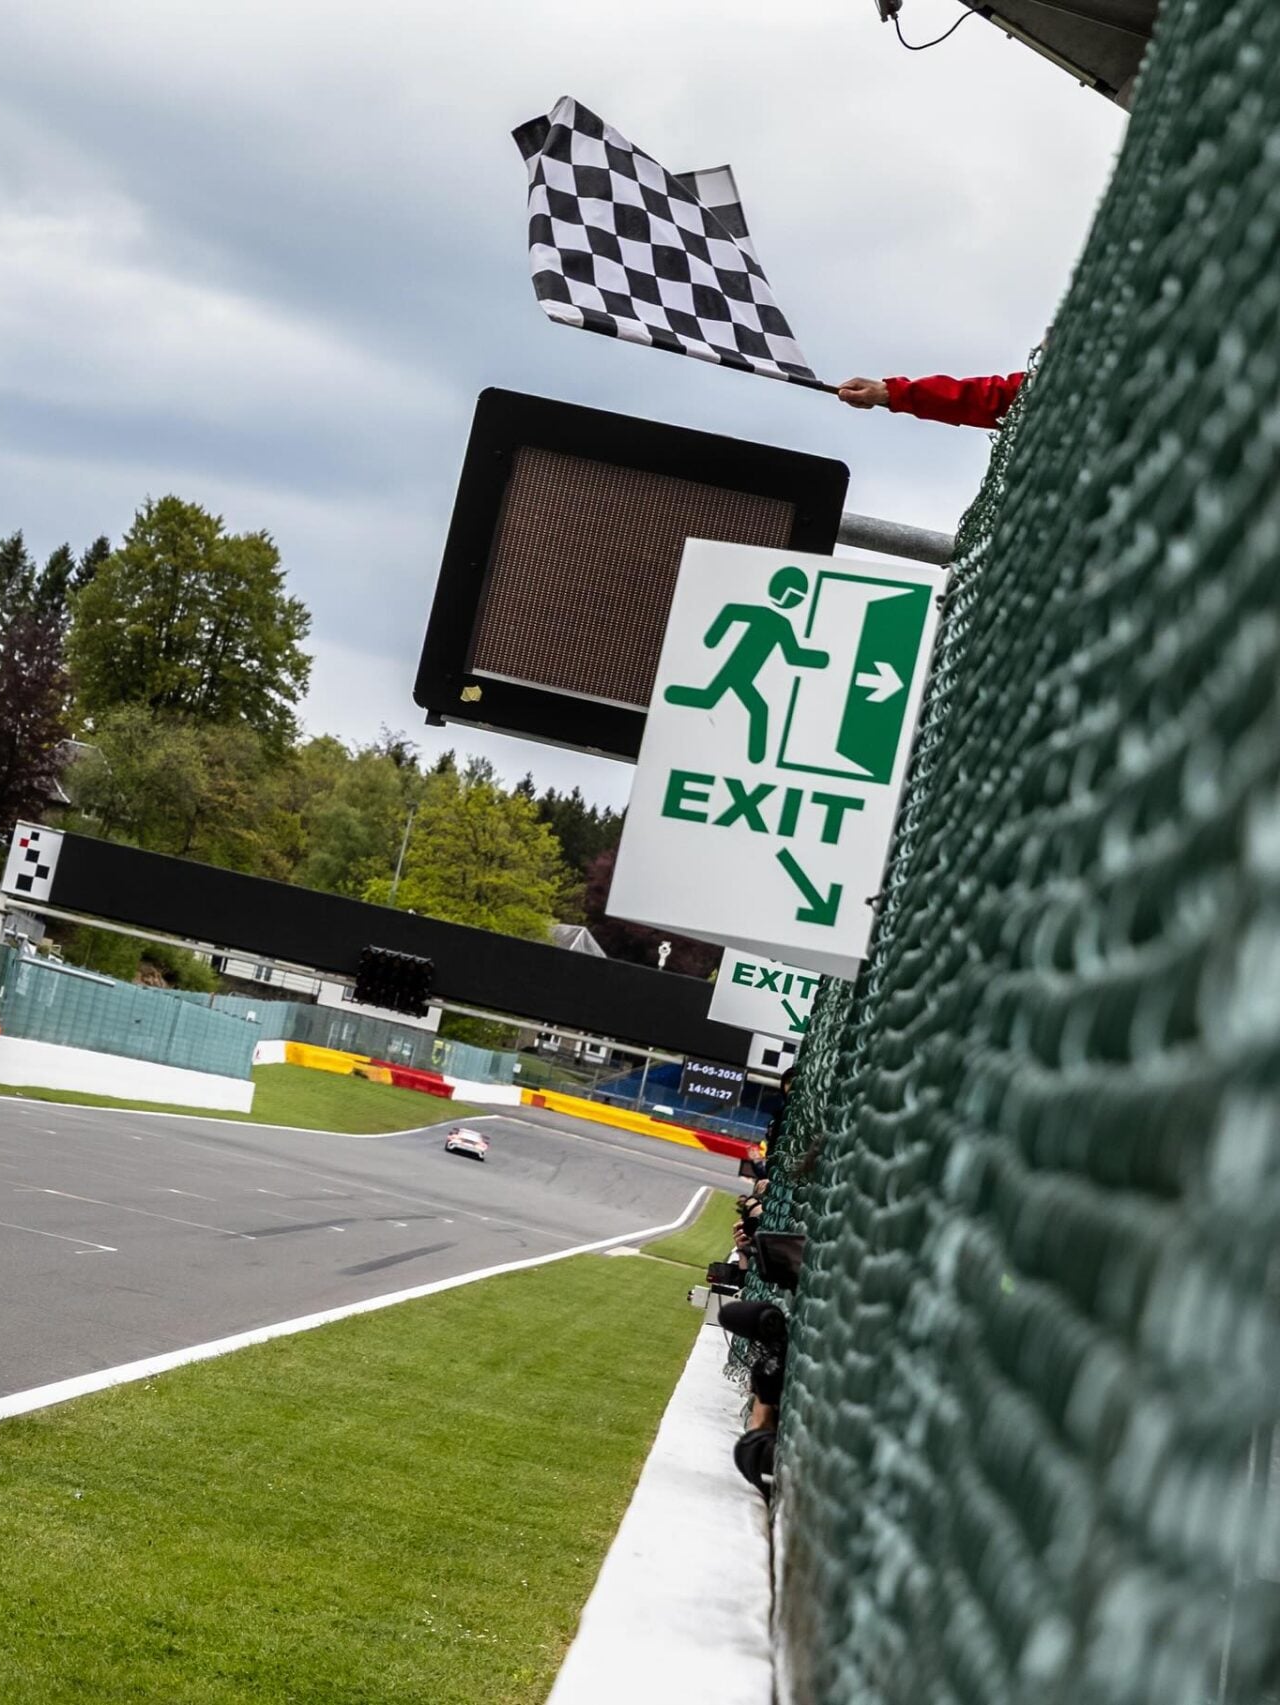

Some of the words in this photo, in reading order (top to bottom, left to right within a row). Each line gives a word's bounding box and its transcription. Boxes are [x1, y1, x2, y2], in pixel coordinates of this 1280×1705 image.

[661, 768, 865, 845] EXIT
[732, 962, 819, 999] EXIT
[686, 1061, 743, 1082] 16-05-2026
[688, 1083, 732, 1100] 14:42:27
